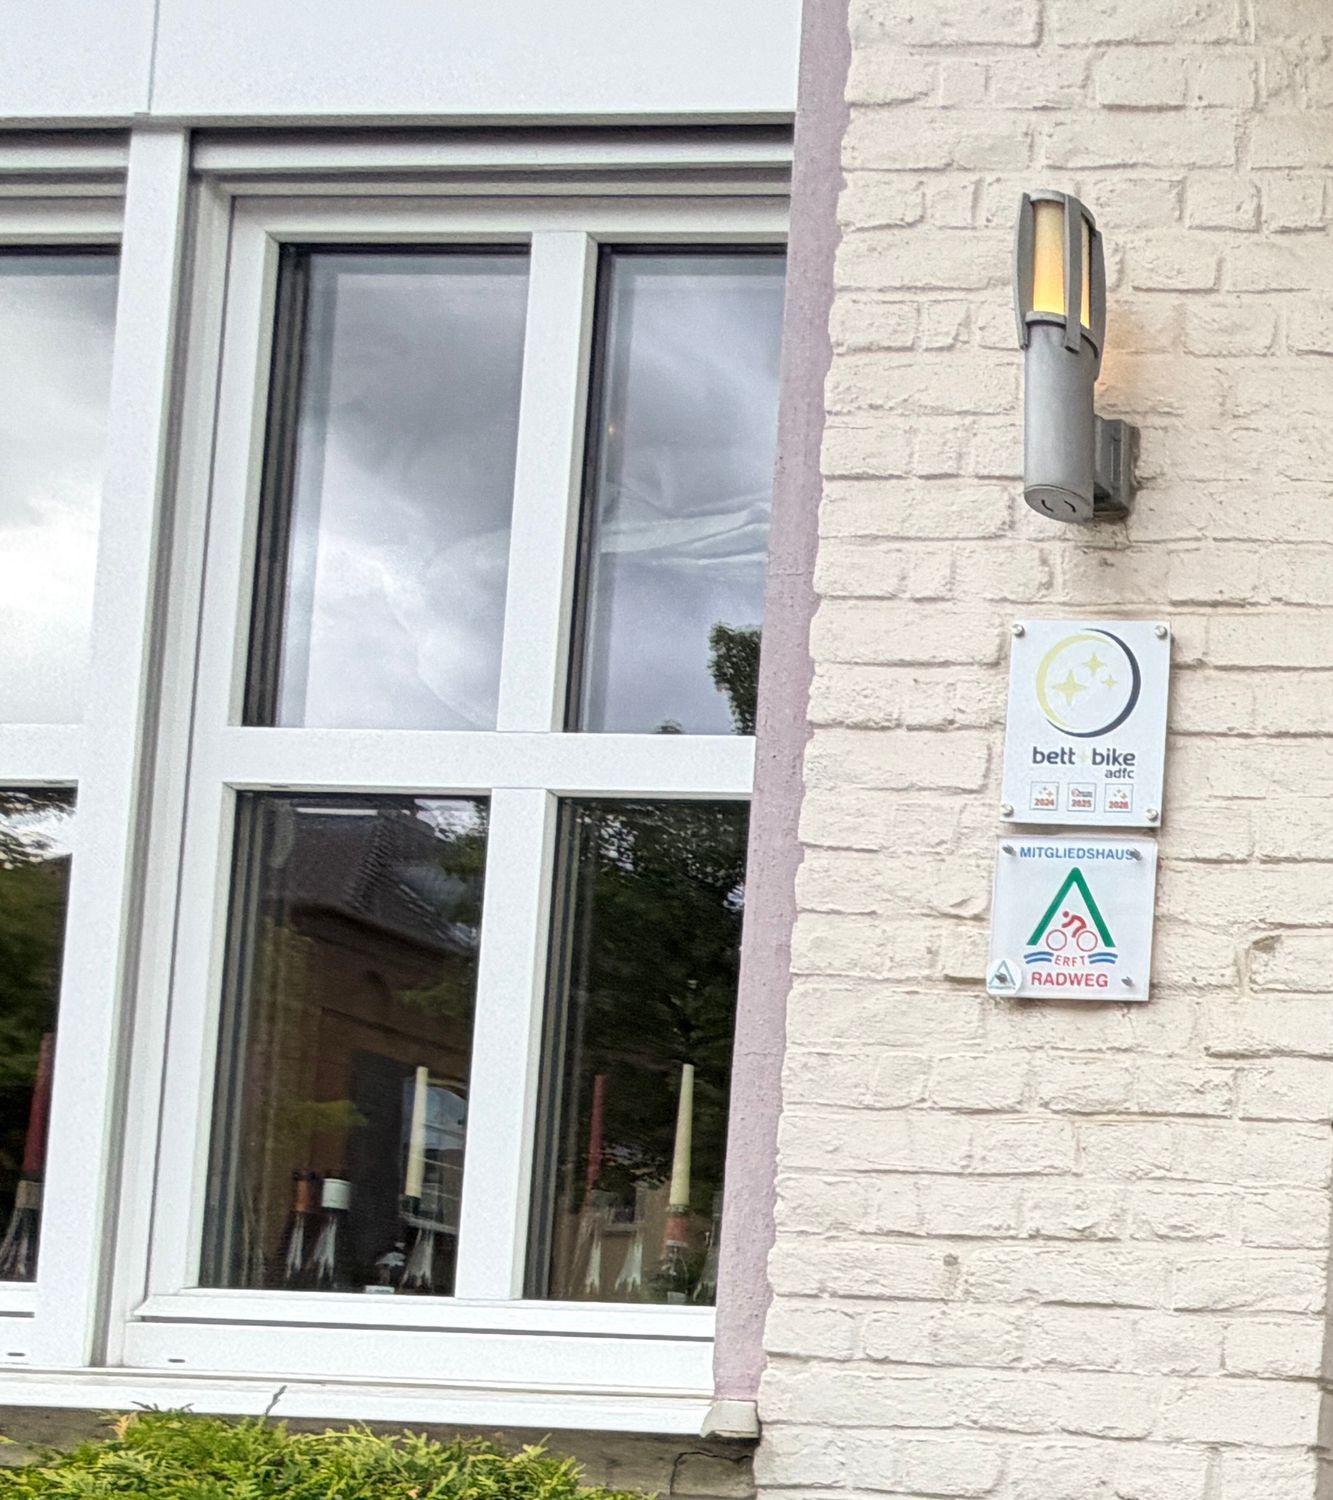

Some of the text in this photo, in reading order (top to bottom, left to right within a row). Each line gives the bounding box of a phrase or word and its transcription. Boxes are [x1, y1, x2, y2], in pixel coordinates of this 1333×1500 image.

[1032, 746, 1136, 767] bett bike
[1104, 768, 1135, 779] adfc
[1020, 846, 1134, 861] MITGLIEDSHAUS
[1054, 954, 1087, 968] ERFT
[1031, 971, 1109, 988] RADWEG
